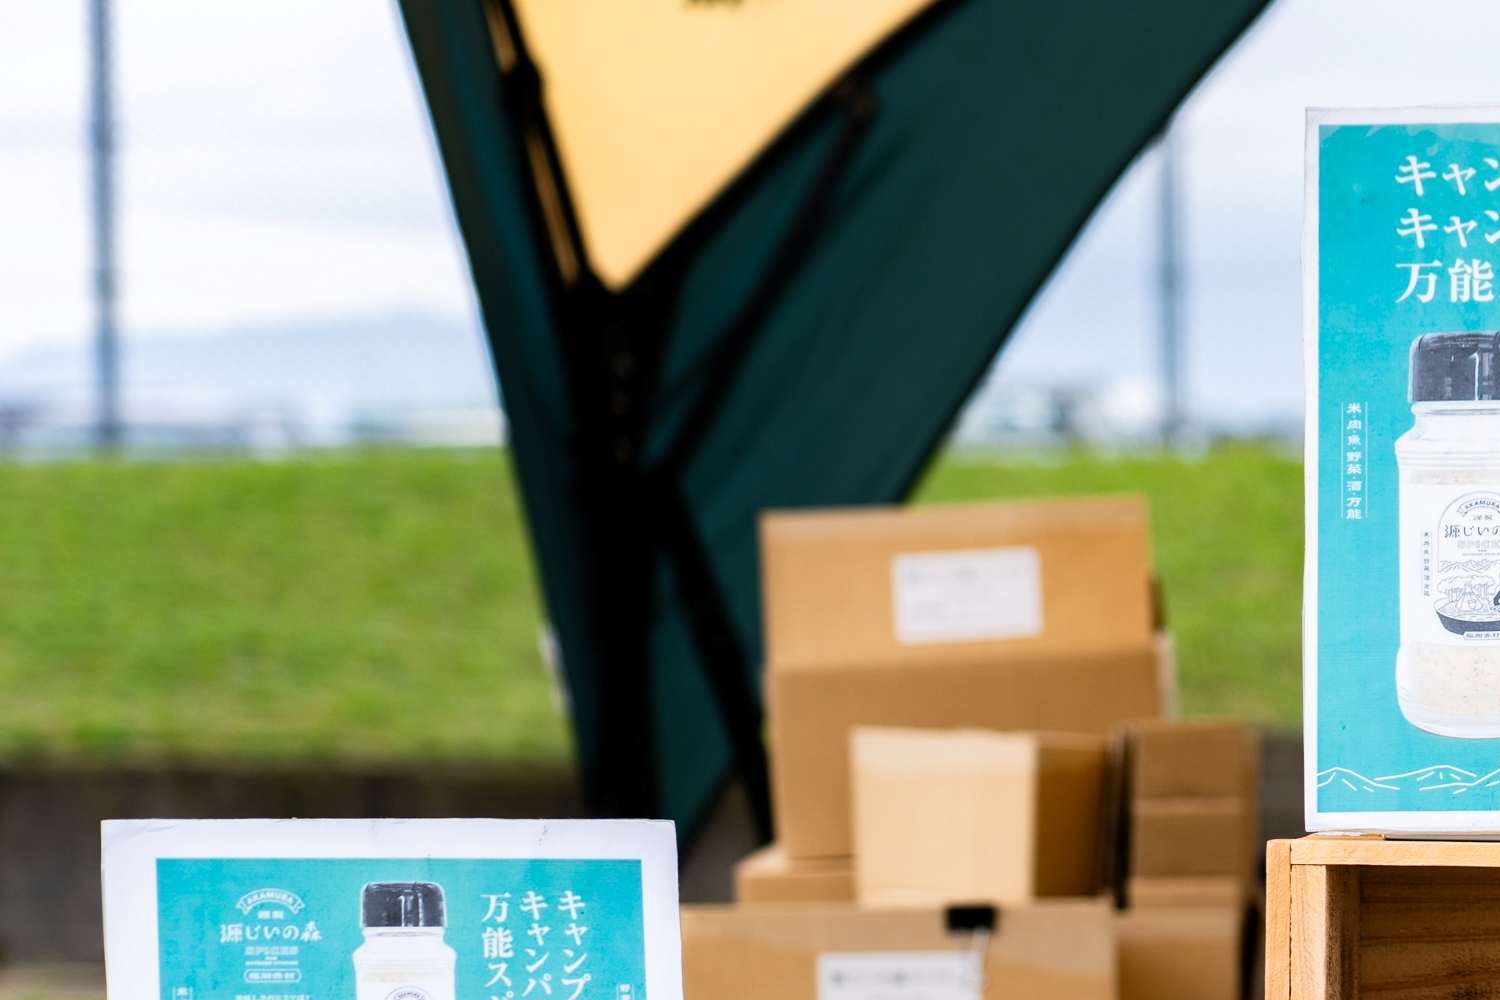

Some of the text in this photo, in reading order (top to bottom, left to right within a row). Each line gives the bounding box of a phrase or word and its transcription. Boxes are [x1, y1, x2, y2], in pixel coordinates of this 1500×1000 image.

[220, 920, 322, 944] 源じいの森
